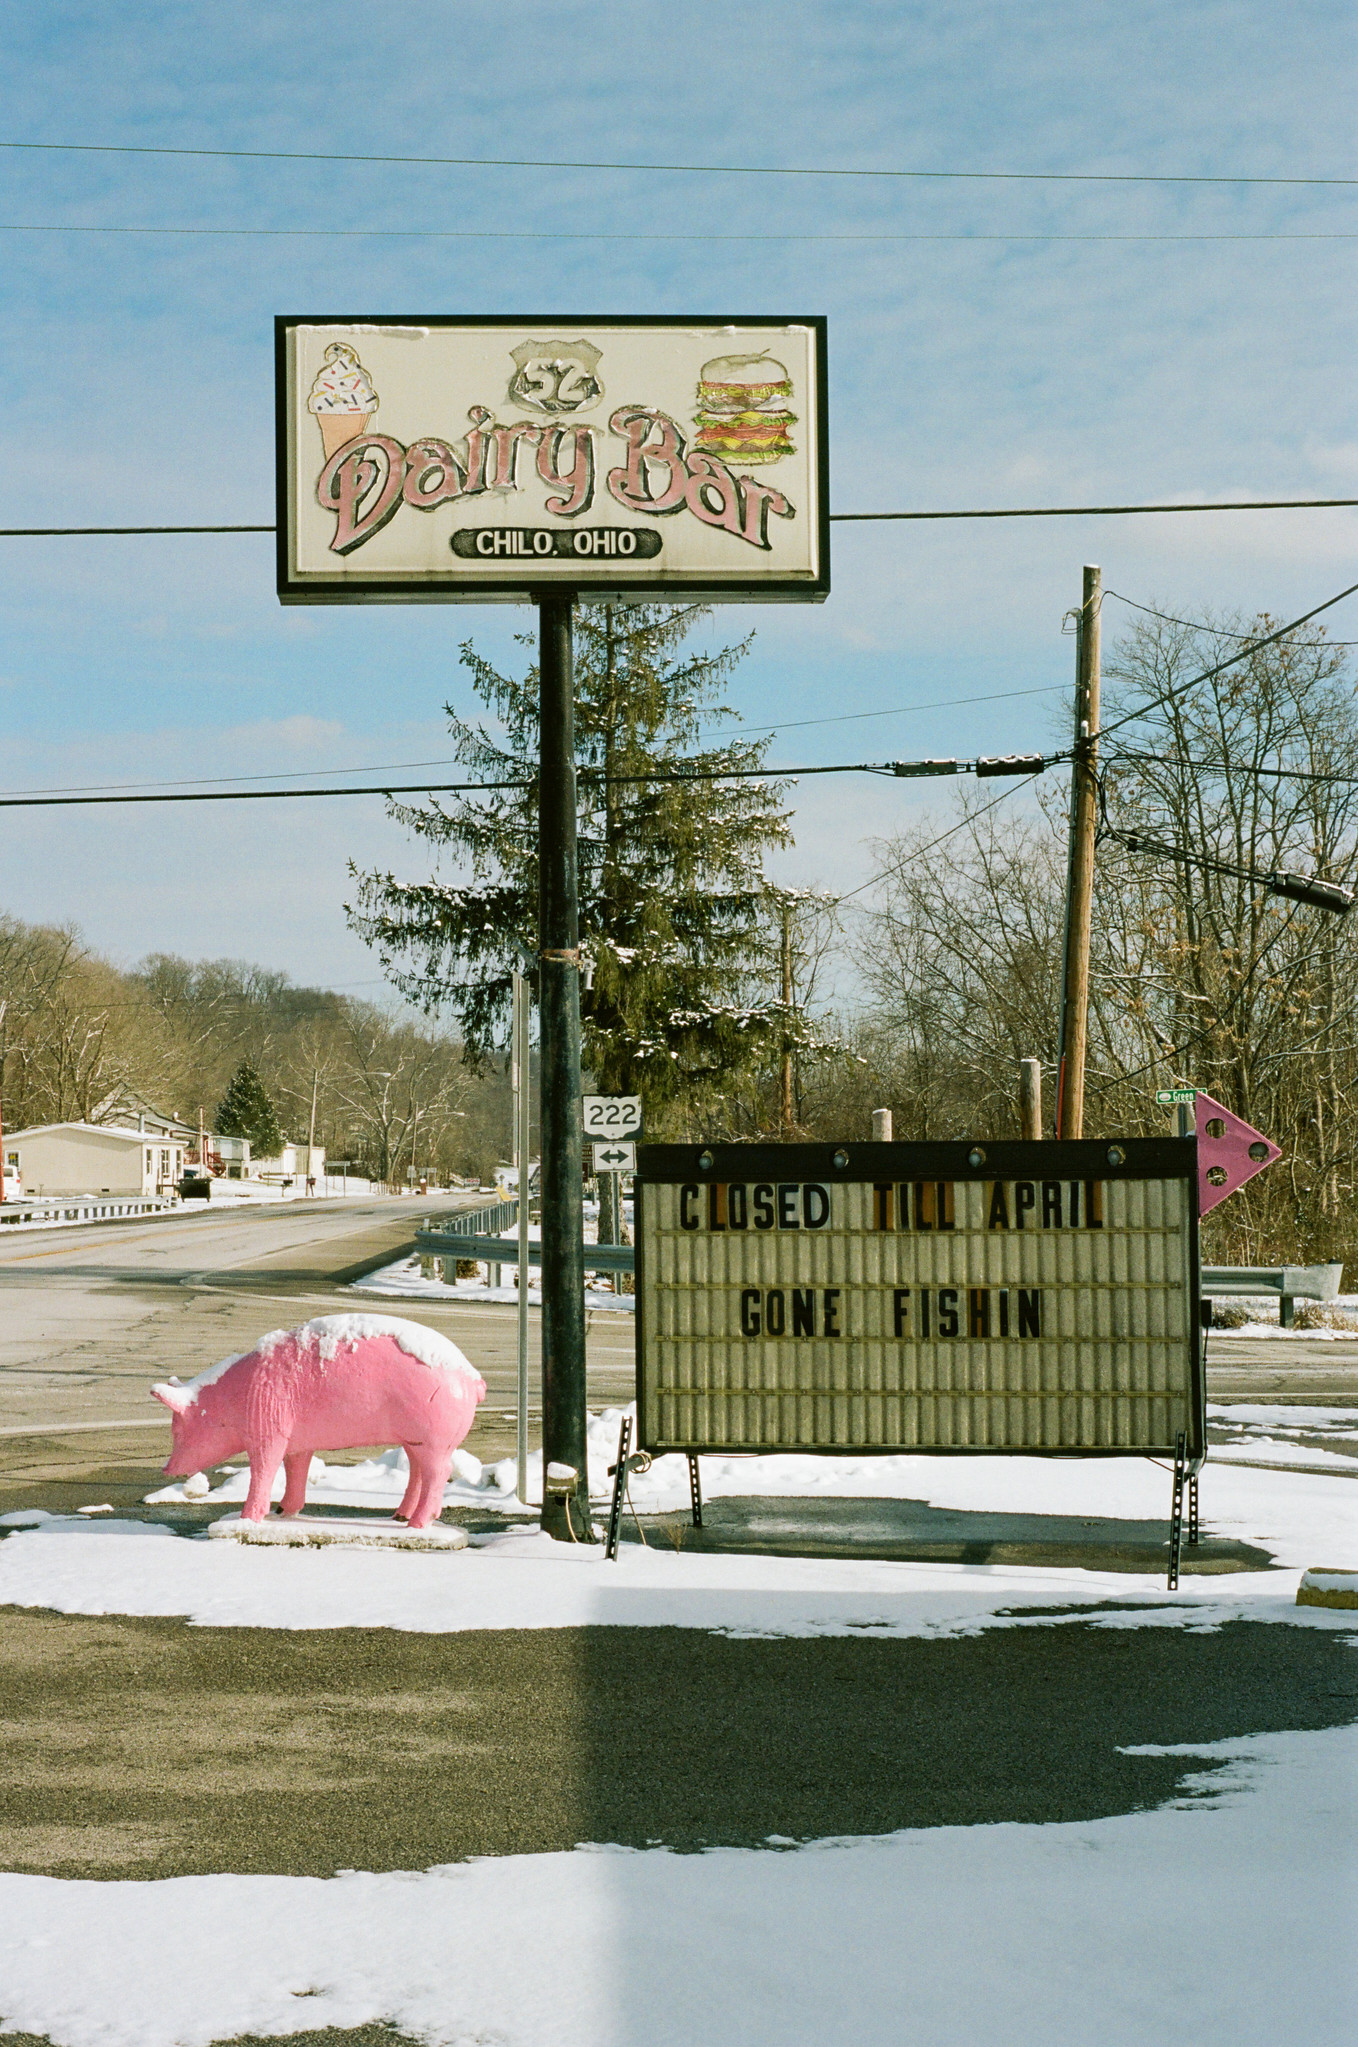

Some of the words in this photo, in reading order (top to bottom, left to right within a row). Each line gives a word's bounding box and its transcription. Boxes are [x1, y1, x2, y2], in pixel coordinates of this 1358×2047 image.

[523, 358, 589, 401] 52
[317, 404, 600, 556] Dairy
[607, 404, 797, 551] Bar
[476, 531, 559, 556] CHILO,
[573, 531, 637, 555] OHIO
[589, 1103, 637, 1125] 222
[1173, 1091, 1194, 1101] Green
[680, 1184, 830, 1231] CLOSED
[874, 1183, 955, 1230] TILL
[989, 1181, 1103, 1230] APRIL
[741, 1288, 841, 1337] GONE
[894, 1289, 1040, 1338] FISHIN
